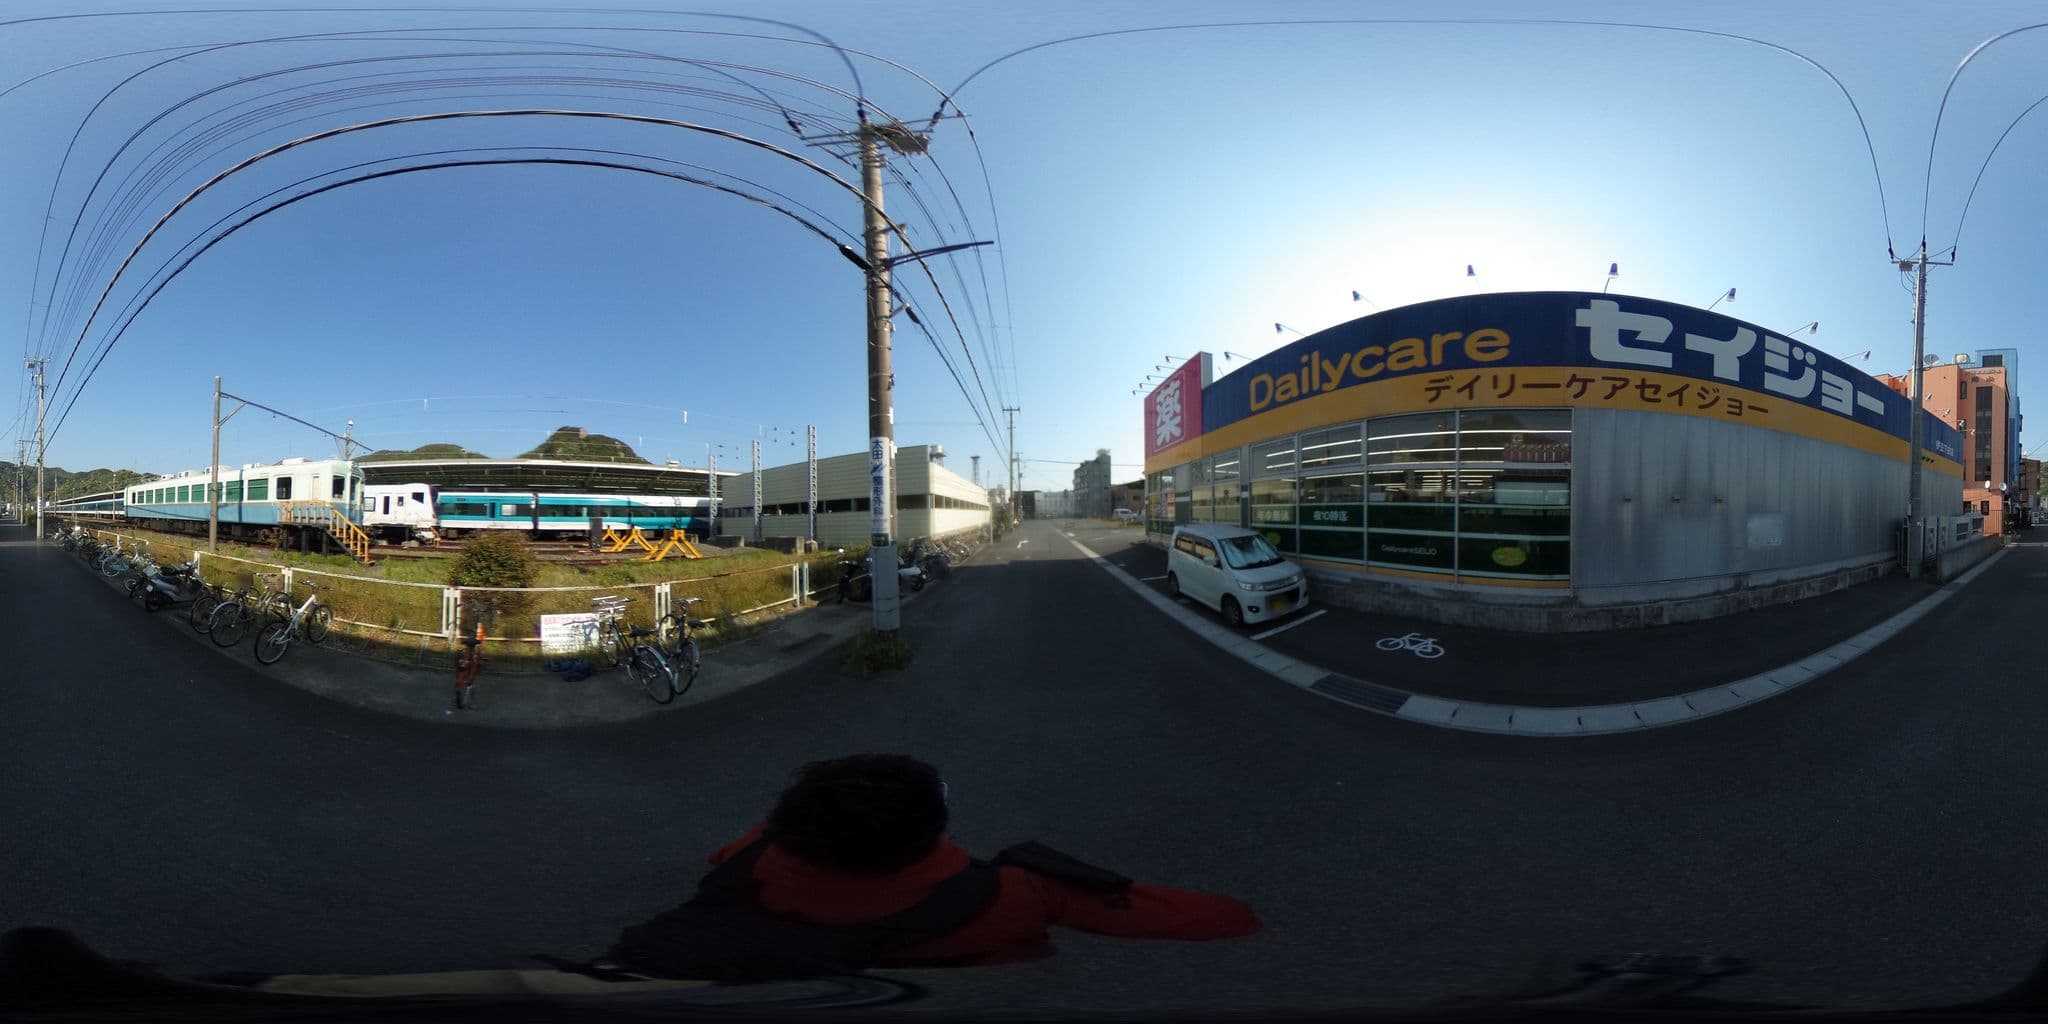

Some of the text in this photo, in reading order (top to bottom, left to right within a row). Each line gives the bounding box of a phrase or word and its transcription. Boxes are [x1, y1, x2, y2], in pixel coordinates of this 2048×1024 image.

[1249, 327, 1512, 412] Dailycare
[1575, 299, 1885, 417] セイジョー
[1155, 379, 1182, 446] 薬
[1424, 373, 1770, 417] デイリーケアセイジョー
[872, 440, 884, 460] 太田
